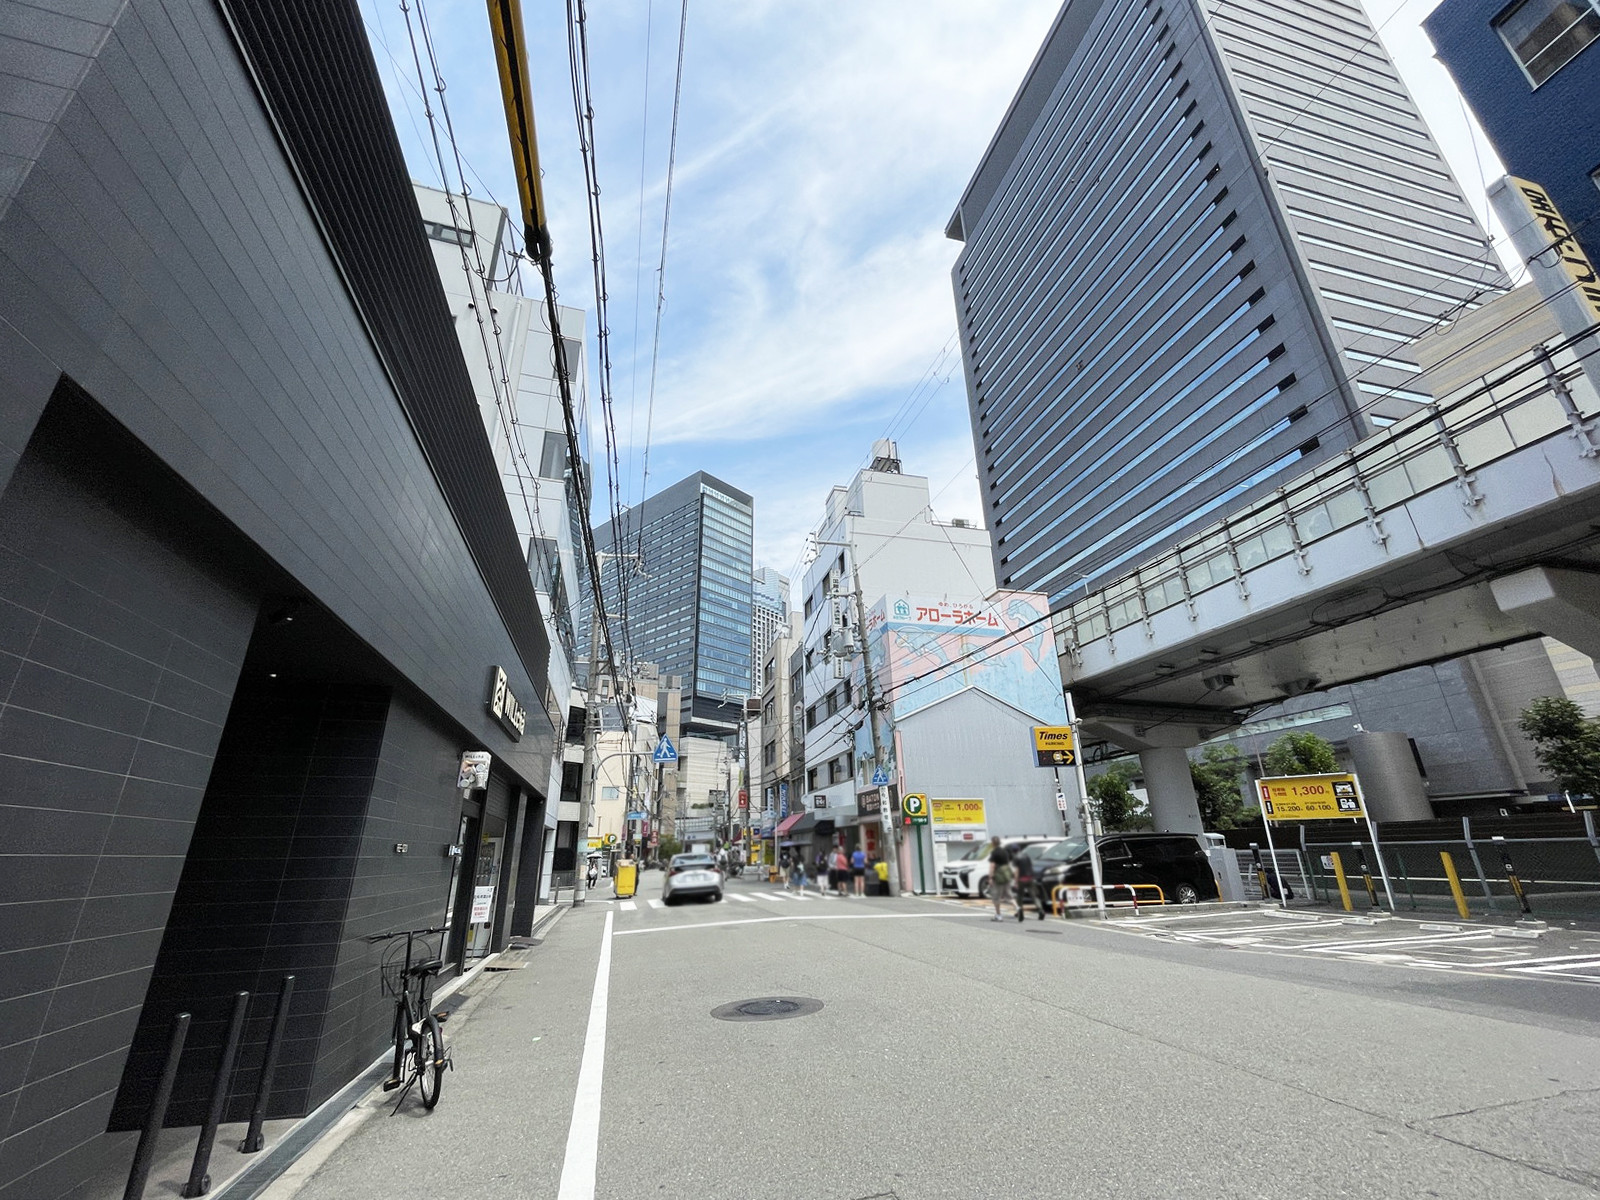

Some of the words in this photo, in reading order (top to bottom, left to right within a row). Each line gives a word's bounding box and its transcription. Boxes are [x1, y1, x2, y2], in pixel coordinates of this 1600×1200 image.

[915, 606, 999, 627] アローラホーム
[1038, 731, 1069, 741] Times
[909, 797, 920, 812] P
[609, 835, 616, 843] P
